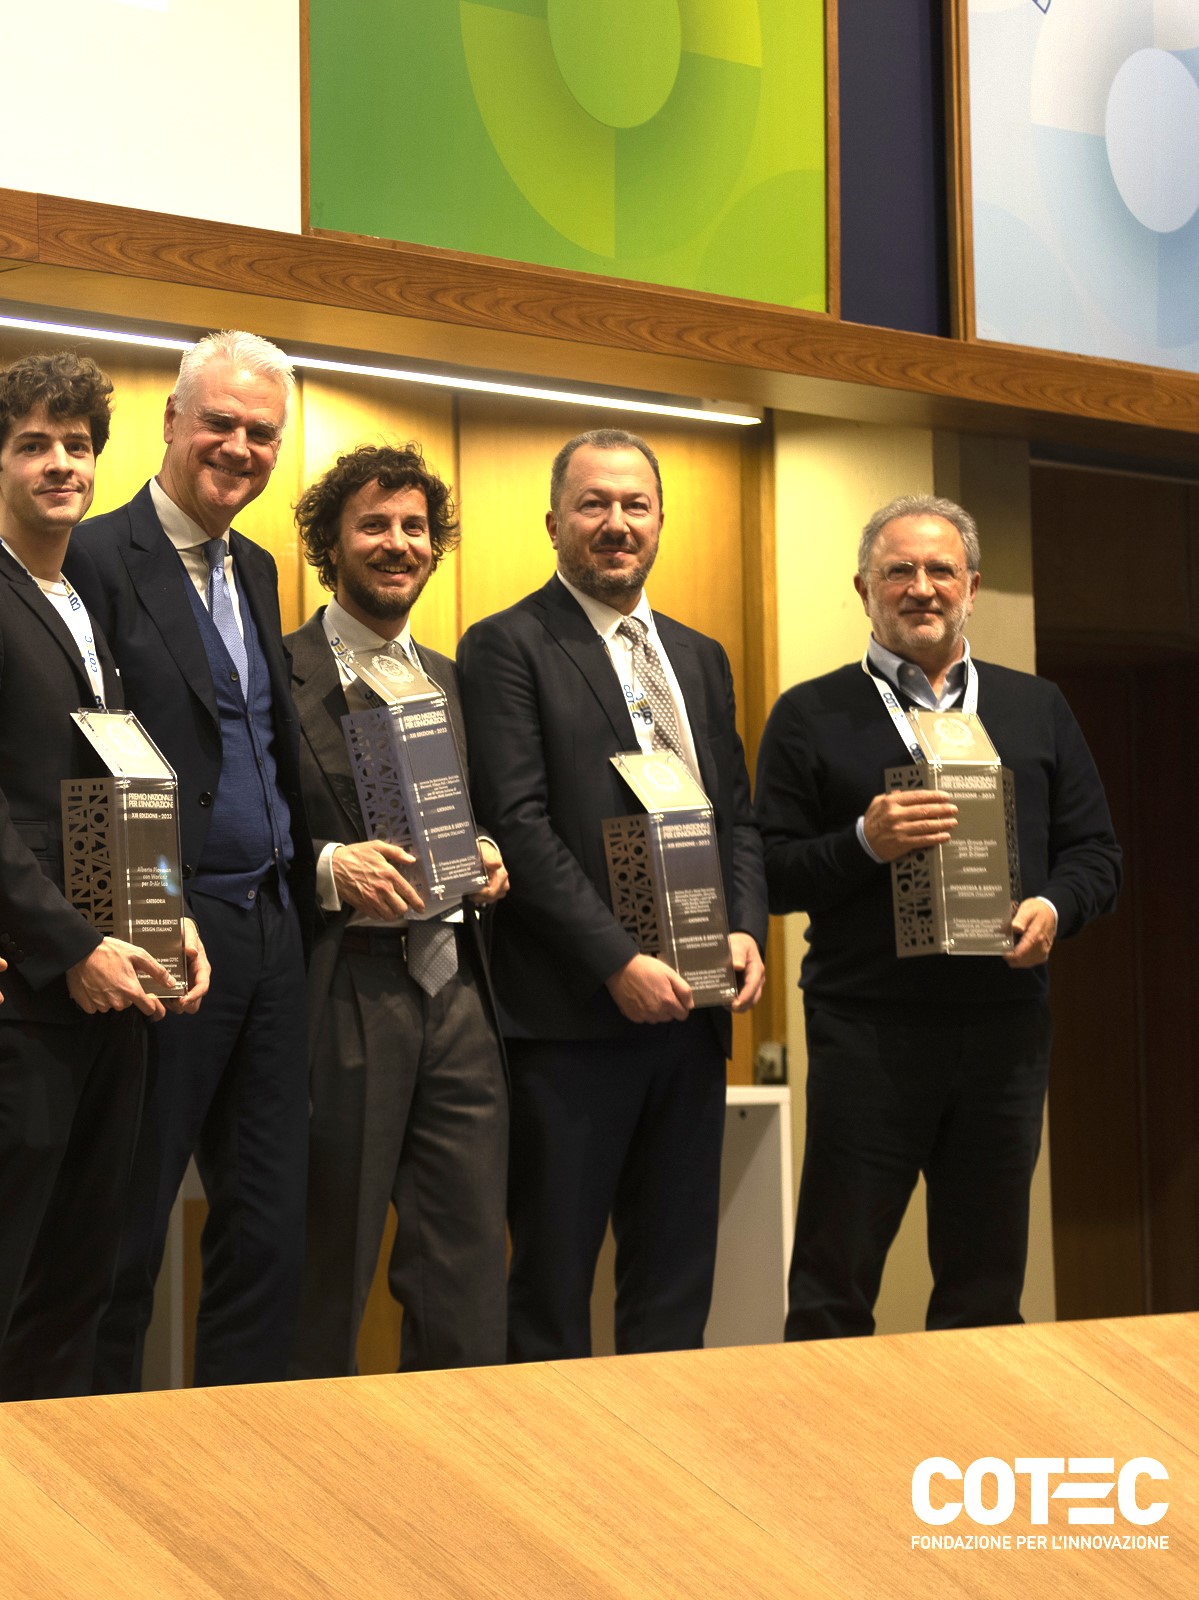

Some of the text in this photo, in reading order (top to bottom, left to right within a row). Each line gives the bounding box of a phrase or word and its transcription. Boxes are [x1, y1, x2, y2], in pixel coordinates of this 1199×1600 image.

[84, 635, 98, 672] COTC
[624, 684, 640, 718] COTEC
[883, 692, 905, 720] COTE
